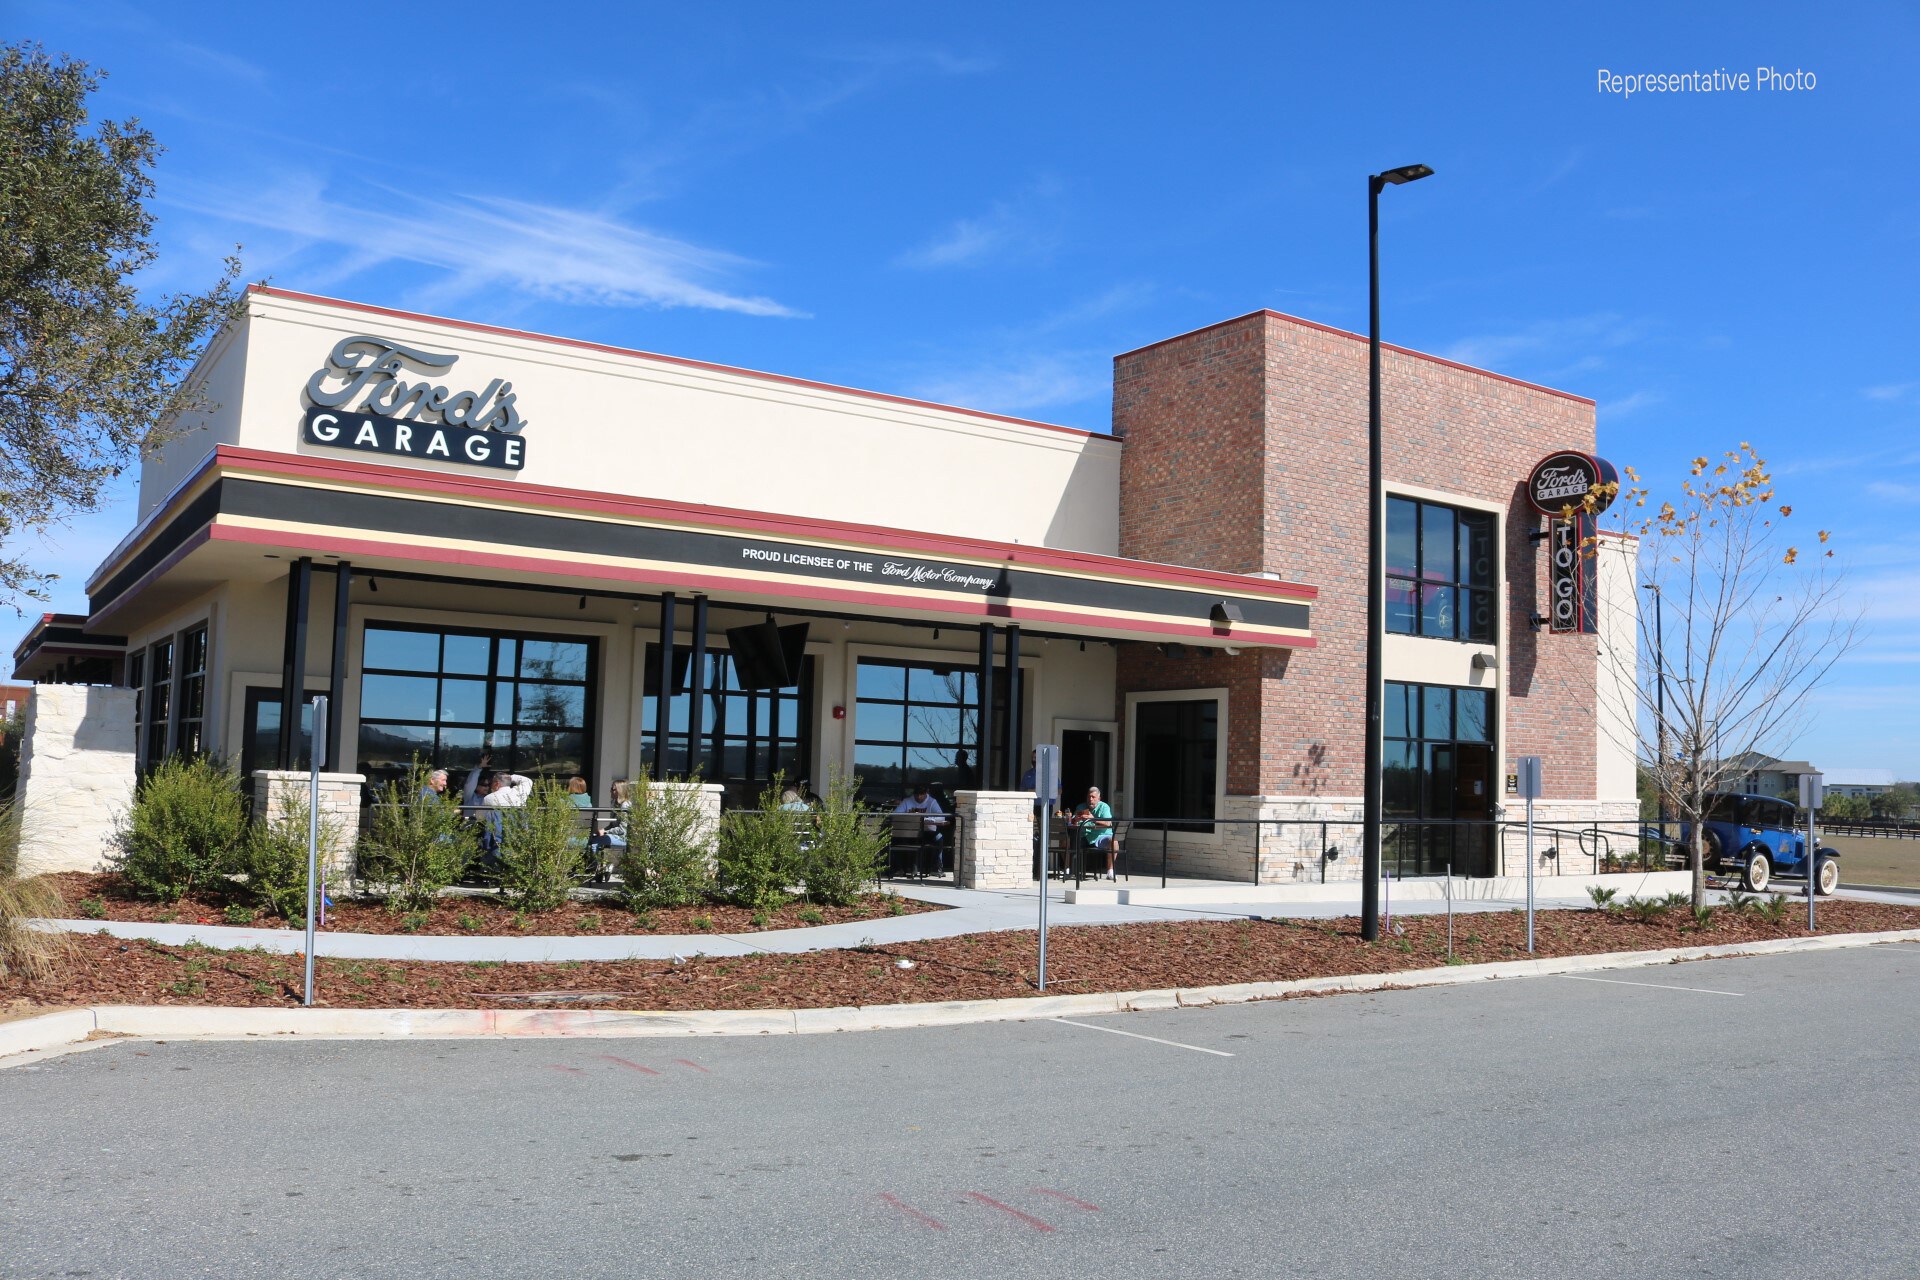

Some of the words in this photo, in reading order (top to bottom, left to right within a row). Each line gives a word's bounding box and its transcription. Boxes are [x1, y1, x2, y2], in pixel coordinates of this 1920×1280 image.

[306, 335, 529, 433] Ford's
[312, 414, 522, 466] GARAGE
[1537, 466, 1587, 489] Ford's
[1539, 484, 1586, 499] GARAGE
[1556, 527, 1573, 568] TO
[742, 548, 781, 562] PROUD
[783, 553, 834, 568] LICENSEE
[836, 559, 850, 569] OF
[853, 561, 873, 573] THE
[881, 561, 909, 578] Ford
[906, 565, 942, 583] Motor
[941, 567, 996, 590] Company
[1556, 577, 1573, 620] GO
